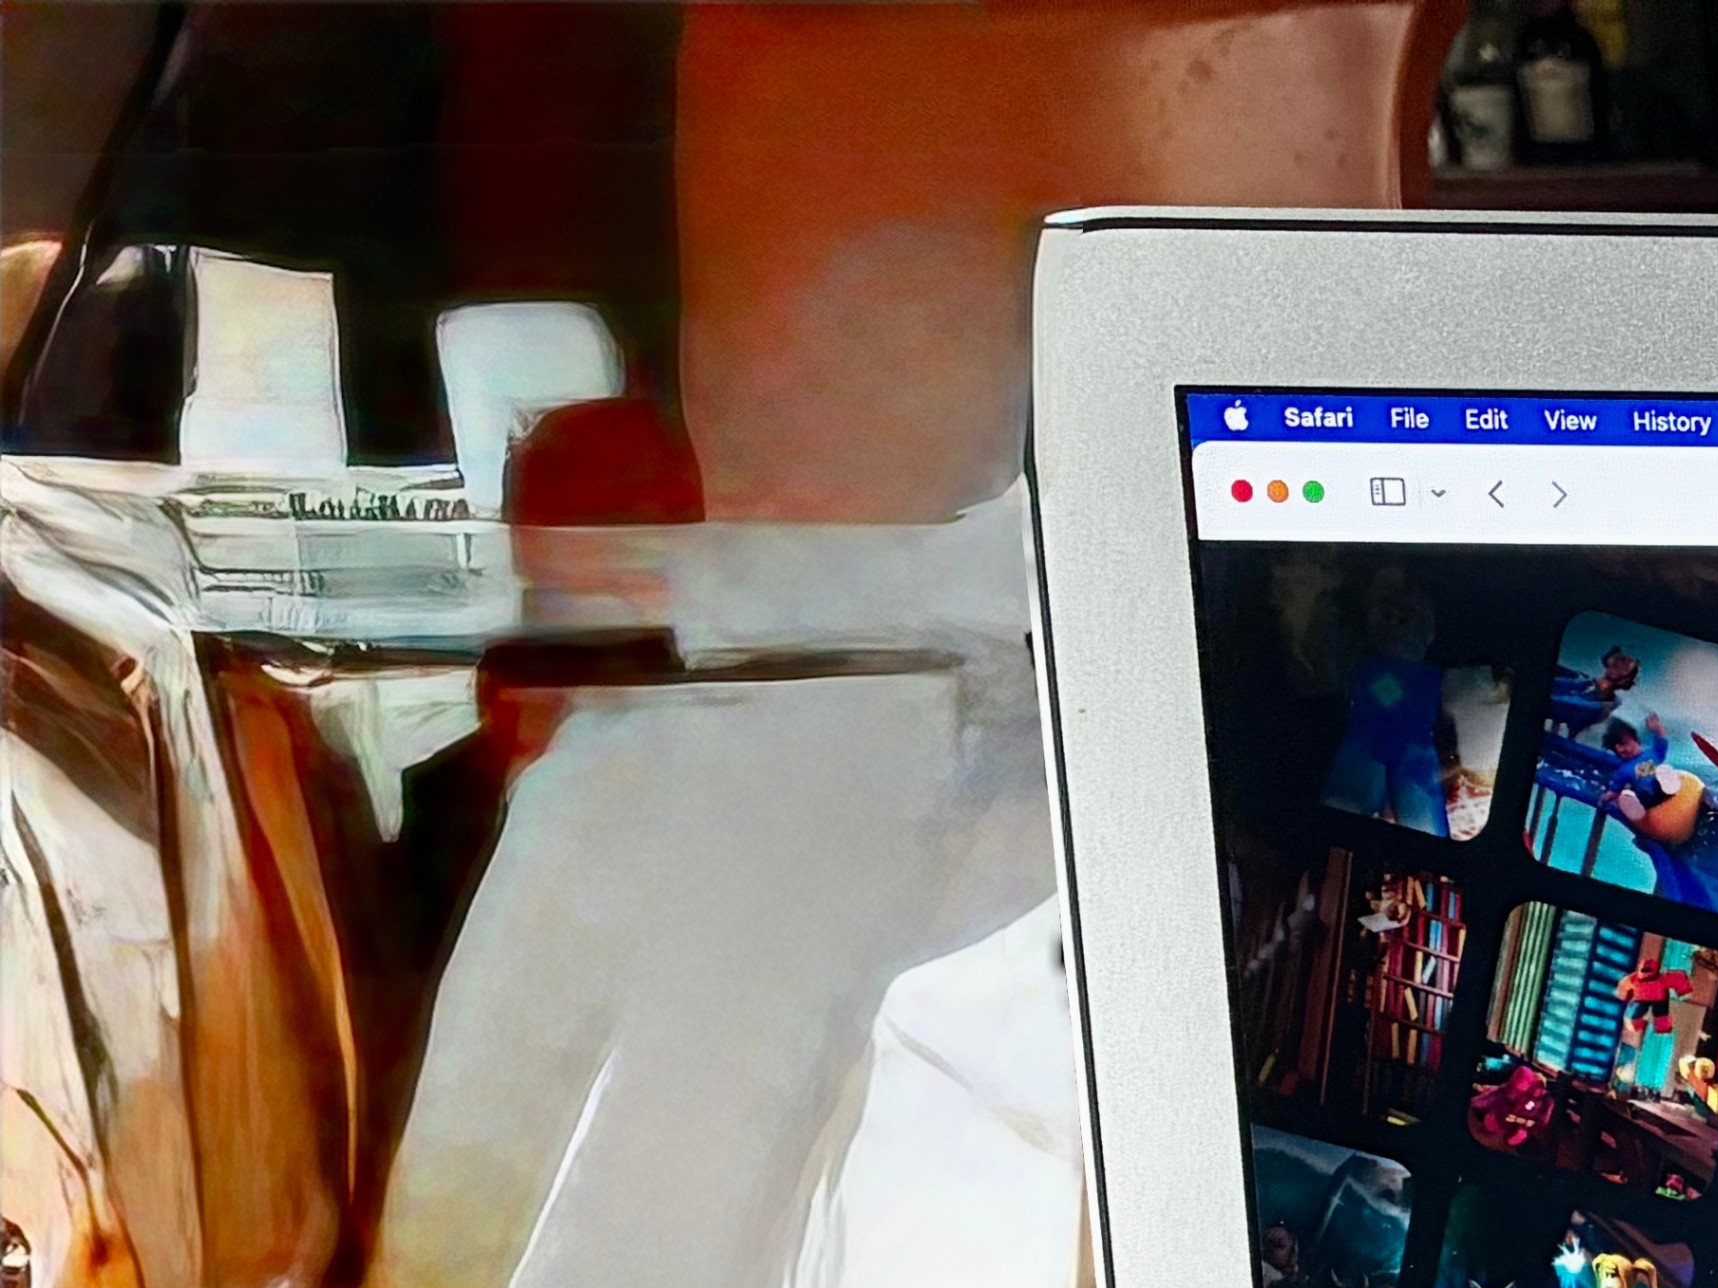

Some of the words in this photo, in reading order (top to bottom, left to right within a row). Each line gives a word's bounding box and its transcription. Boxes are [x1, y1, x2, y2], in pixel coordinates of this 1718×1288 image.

[1284, 406, 1354, 428] Safari
[1390, 406, 1430, 429] File
[1465, 407, 1509, 430] Edit
[1544, 408, 1598, 431] View
[1633, 409, 1712, 436] History
